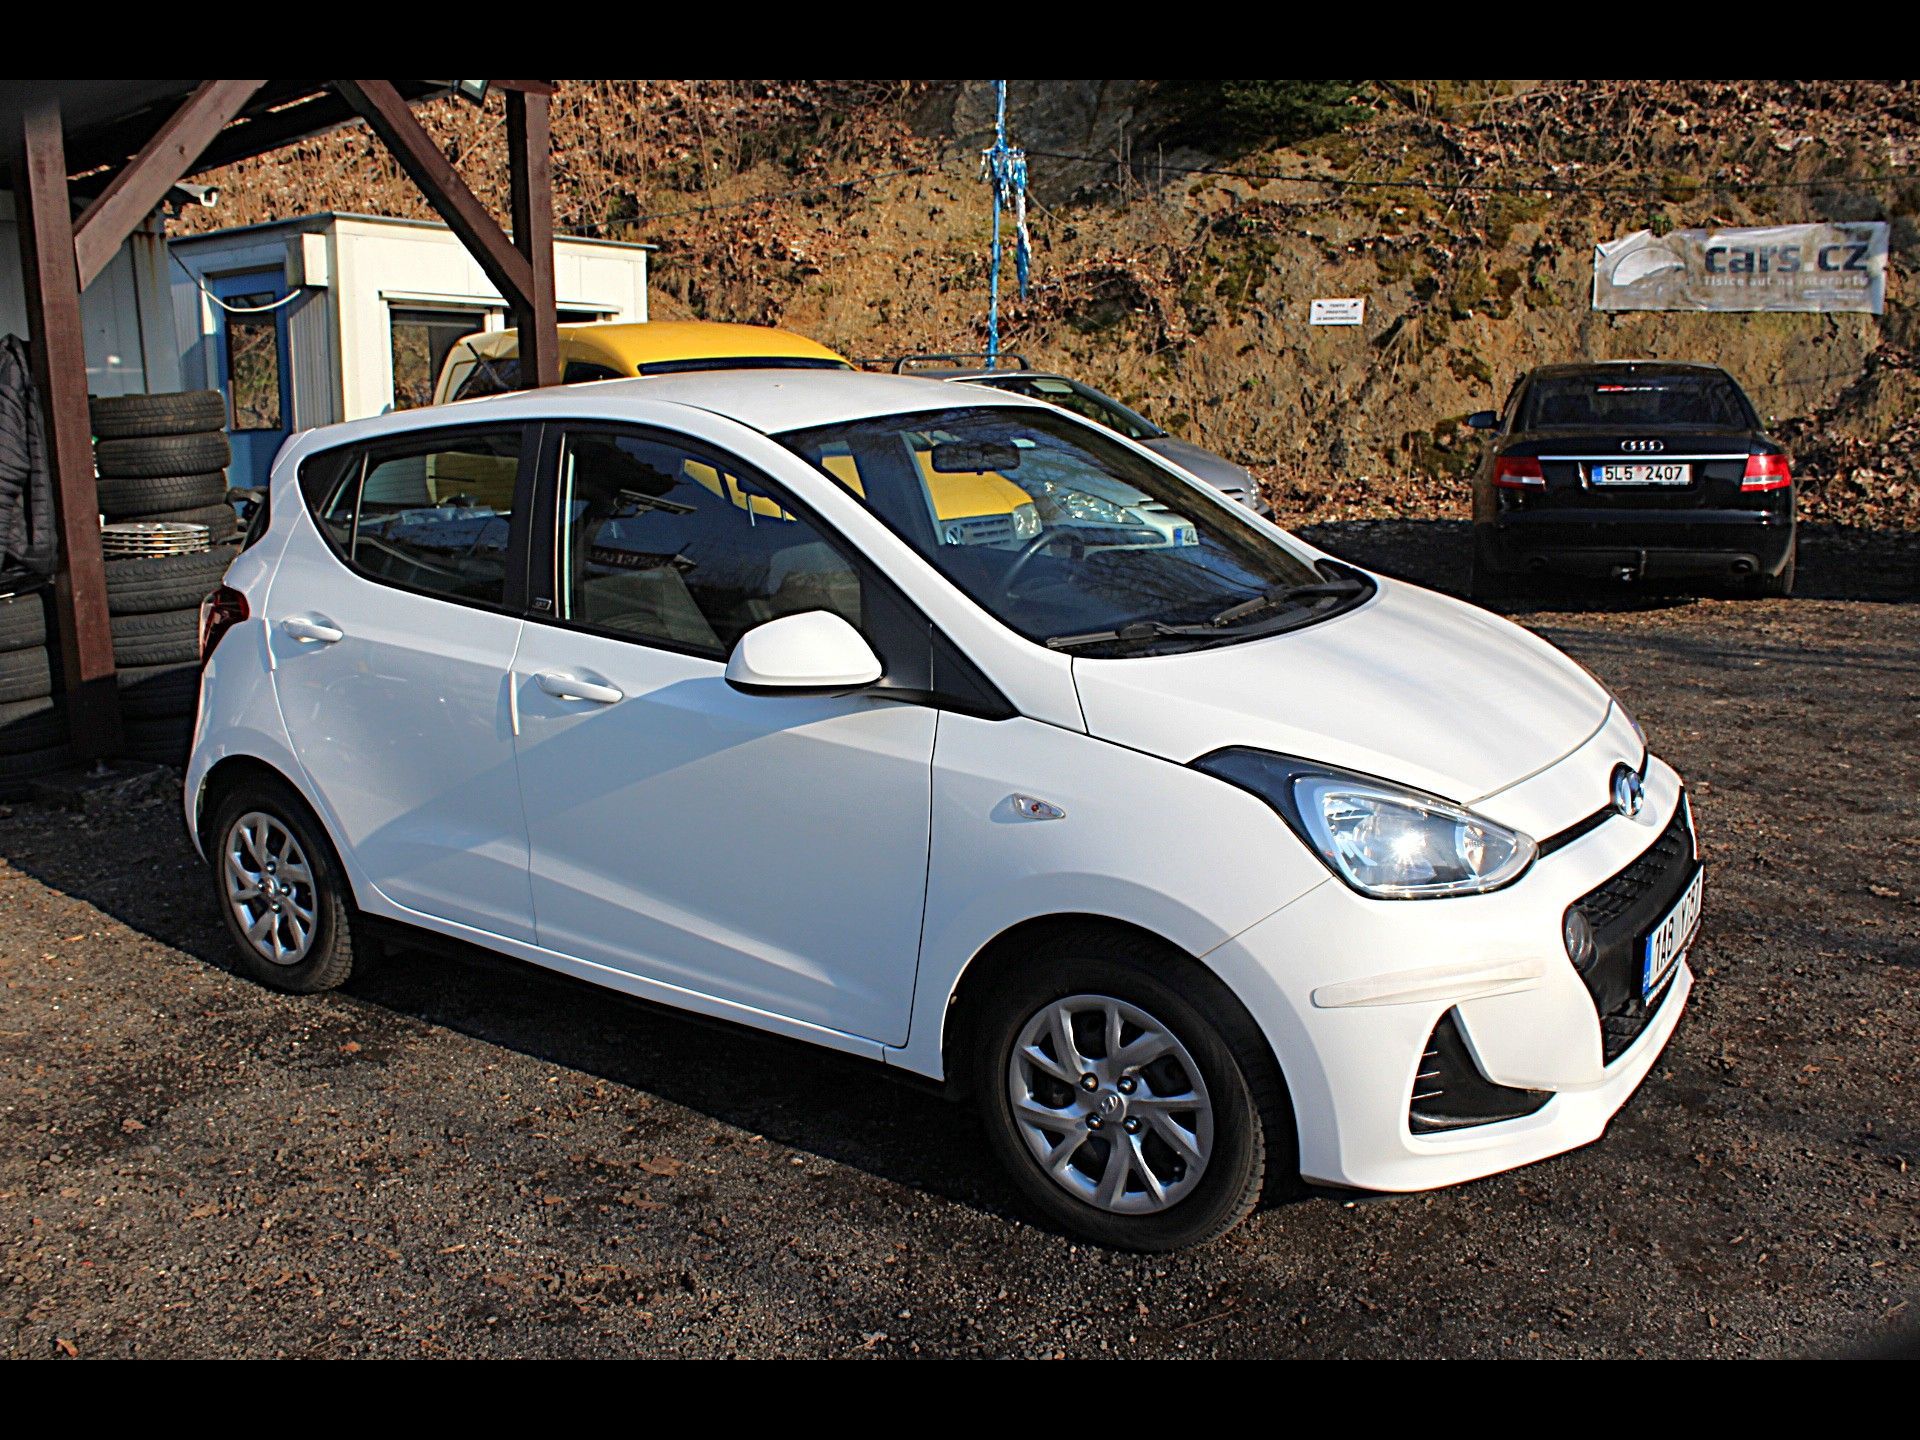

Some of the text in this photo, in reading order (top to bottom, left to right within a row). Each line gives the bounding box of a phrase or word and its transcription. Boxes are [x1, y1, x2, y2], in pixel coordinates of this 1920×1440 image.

[1705, 243, 1868, 273] cars.cz
[1605, 466, 1683, 481] 5L5 2407
